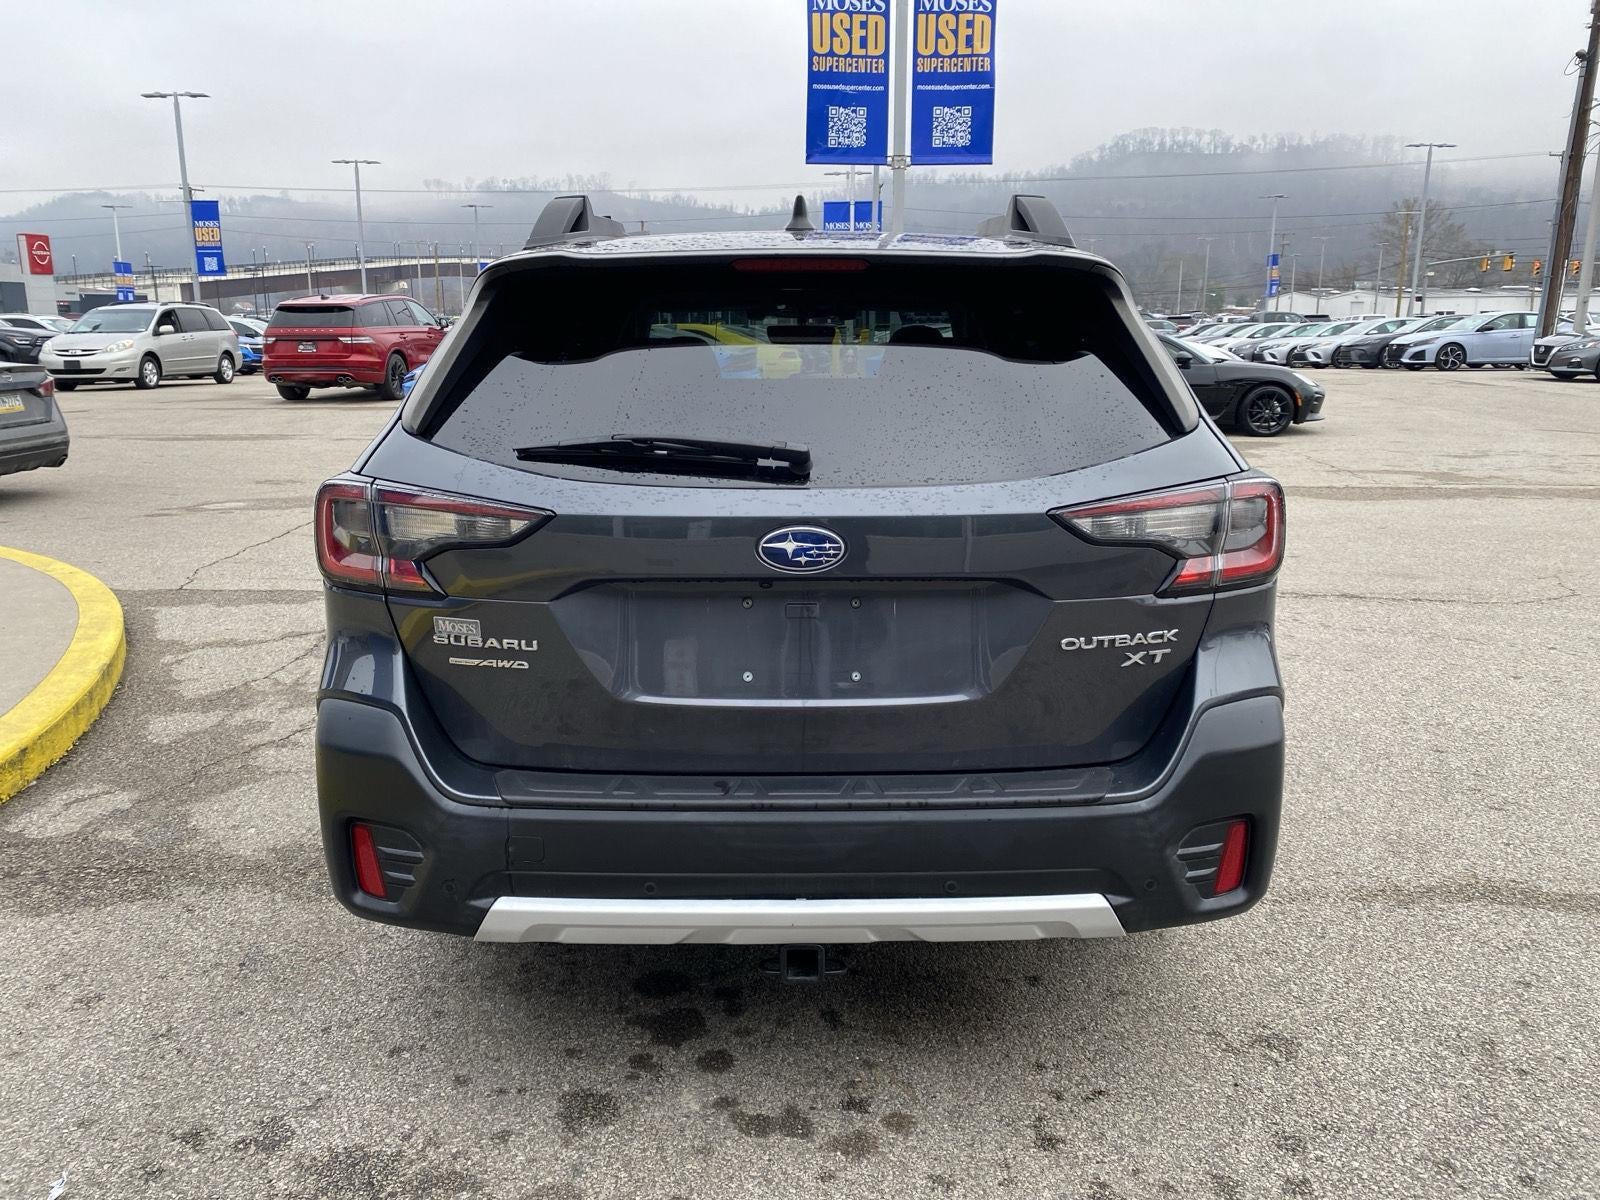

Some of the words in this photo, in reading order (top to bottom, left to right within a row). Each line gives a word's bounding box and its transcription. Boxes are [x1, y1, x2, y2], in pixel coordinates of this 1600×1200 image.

[812, 0, 886, 12] MOSES
[918, 0, 992, 12] MOSES
[812, 12, 886, 56] USED
[917, 13, 992, 56] USED
[812, 55, 885, 74] SUPERCENTER
[917, 56, 991, 73] SUPERCENTER
[812, 83, 885, 92] mosesusedsupercenter.com
[917, 83, 991, 92] mosesusedsupercenter.com
[825, 222, 850, 230] MOSES
[855, 222, 880, 230] MOSS
[195, 227, 220, 241] USED
[438, 620, 476, 633] MOSES
[433, 634, 538, 650] SUBARU
[1061, 629, 1179, 650] OUTBACK
[479, 659, 530, 669] AWD
[1121, 648, 1171, 667] XT
